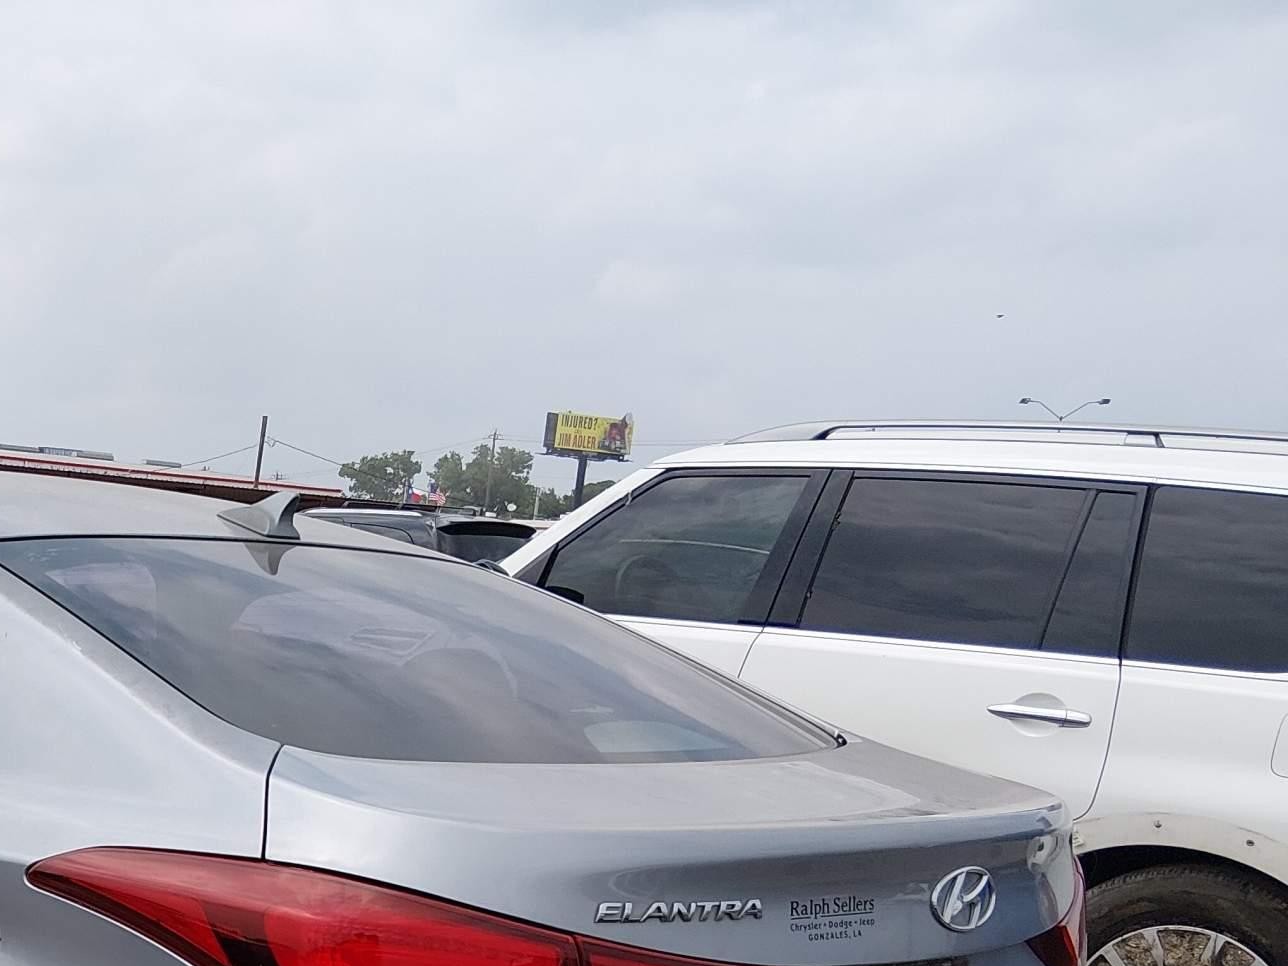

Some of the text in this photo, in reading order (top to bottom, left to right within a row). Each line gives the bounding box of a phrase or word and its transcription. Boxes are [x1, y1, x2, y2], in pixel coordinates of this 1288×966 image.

[561, 414, 598, 430] INJURED?
[558, 432, 596, 449] JIM ADLER
[594, 899, 763, 924] ELANTRA
[790, 896, 875, 919] Ralph Sellers
[790, 918, 875, 932] Chrysler Dodge Jeep
[808, 929, 862, 942] GONZALES, LA
